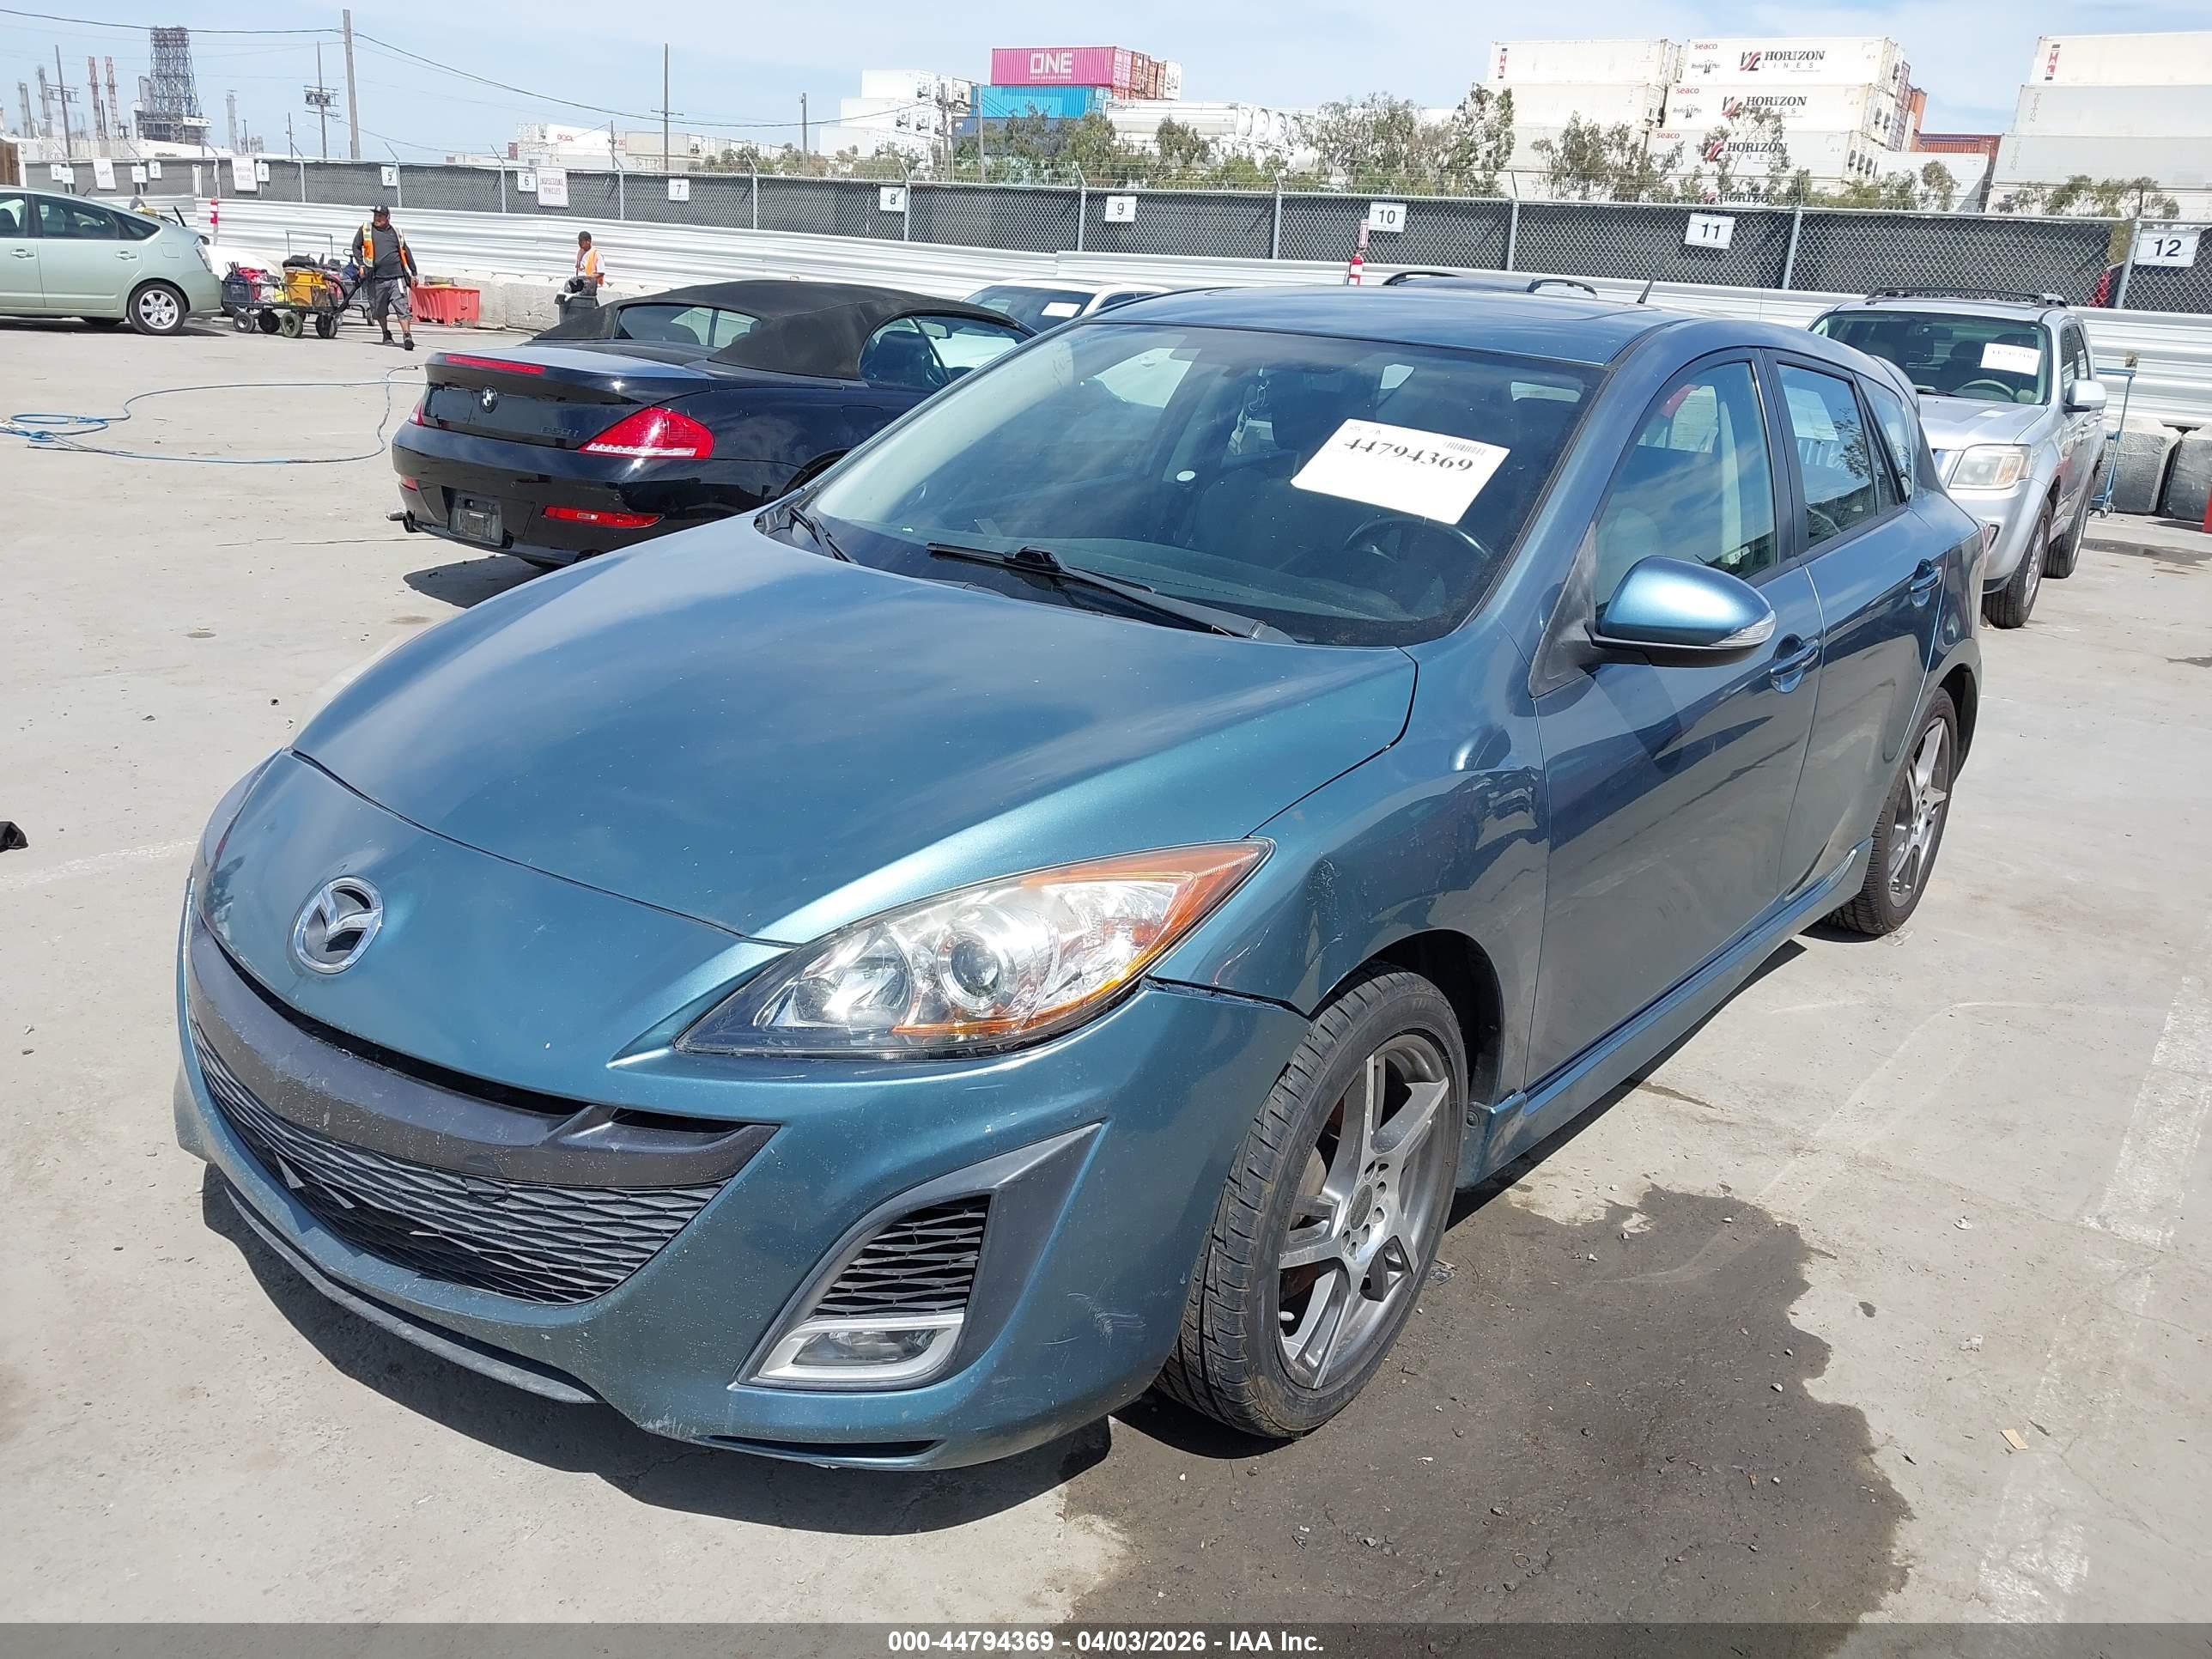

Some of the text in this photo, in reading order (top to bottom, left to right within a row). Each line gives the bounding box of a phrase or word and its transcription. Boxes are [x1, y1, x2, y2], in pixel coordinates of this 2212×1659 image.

[1764, 51, 1826, 61] HORIZON
[1030, 53, 1073, 73] ONE
[1746, 96, 1808, 106] HORIZON
[1727, 142, 1788, 153] HORIZON
[524, 175, 530, 186] 6
[676, 184, 682, 195] 7
[890, 192, 896, 205] 8
[1117, 202, 1125, 216] 9
[1378, 209, 1396, 224] 10
[1701, 222, 1721, 240] 11
[2154, 238, 2182, 257] 12
[1344, 437, 1474, 471] 44794369
